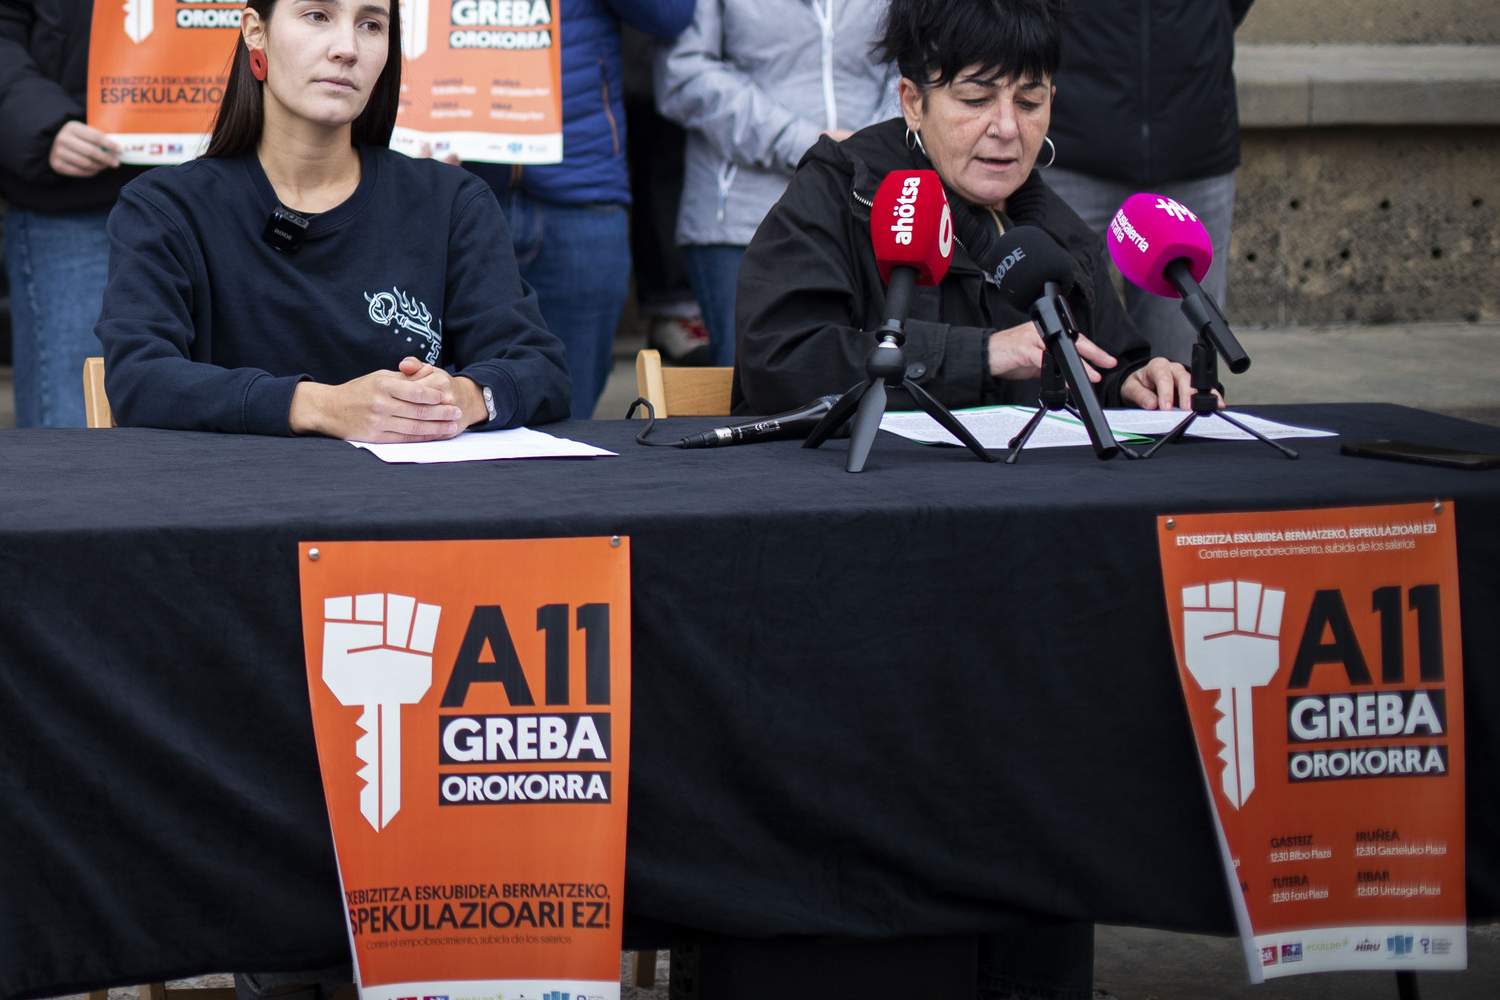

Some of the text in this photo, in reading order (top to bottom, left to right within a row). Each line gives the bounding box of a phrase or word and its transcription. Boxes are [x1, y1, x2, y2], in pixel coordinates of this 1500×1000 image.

[176, 9, 242, 28] OROKO
[450, 30, 552, 50] OROKORRA
[100, 87, 223, 104] ESPEKULAZIO
[891, 177, 920, 246] ahötsa
[1176, 523, 1437, 546] ETXEBIZITZA ESKUBIDEA BERMATZEKO, ESPEKULAZIOARI EZ!
[1199, 548, 1229, 560] Contra
[1230, 547, 1239, 558] el
[1384, 538, 1415, 550] salarios
[1287, 584, 1445, 689] A11
[440, 602, 610, 708] A11
[1290, 692, 1443, 740] GREBA
[443, 716, 608, 762] GREBA
[1290, 748, 1446, 778] OROKORRA
[442, 774, 608, 802] OROKORRA
[1271, 836, 1314, 848] GASTEIZ
[1356, 829, 1400, 842] IRUÑEA
[1312, 849, 1332, 858] Plaza
[1357, 846, 1376, 856] 12:30
[1426, 844, 1446, 854] Plaza
[1272, 876, 1308, 888] TUTERA
[1358, 871, 1390, 882] EIBAR
[346, 884, 610, 905] XEBIZITZA ESKUBIDEA BERMATZEKO,
[1309, 890, 1328, 898] Plaza
[1358, 886, 1378, 896] 12:00
[1420, 886, 1440, 895] Plaza
[350, 902, 610, 936] SPEKULAZIOARI EZ!
[366, 934, 572, 950] Contra el empobrecimiento, subida de los salarios
